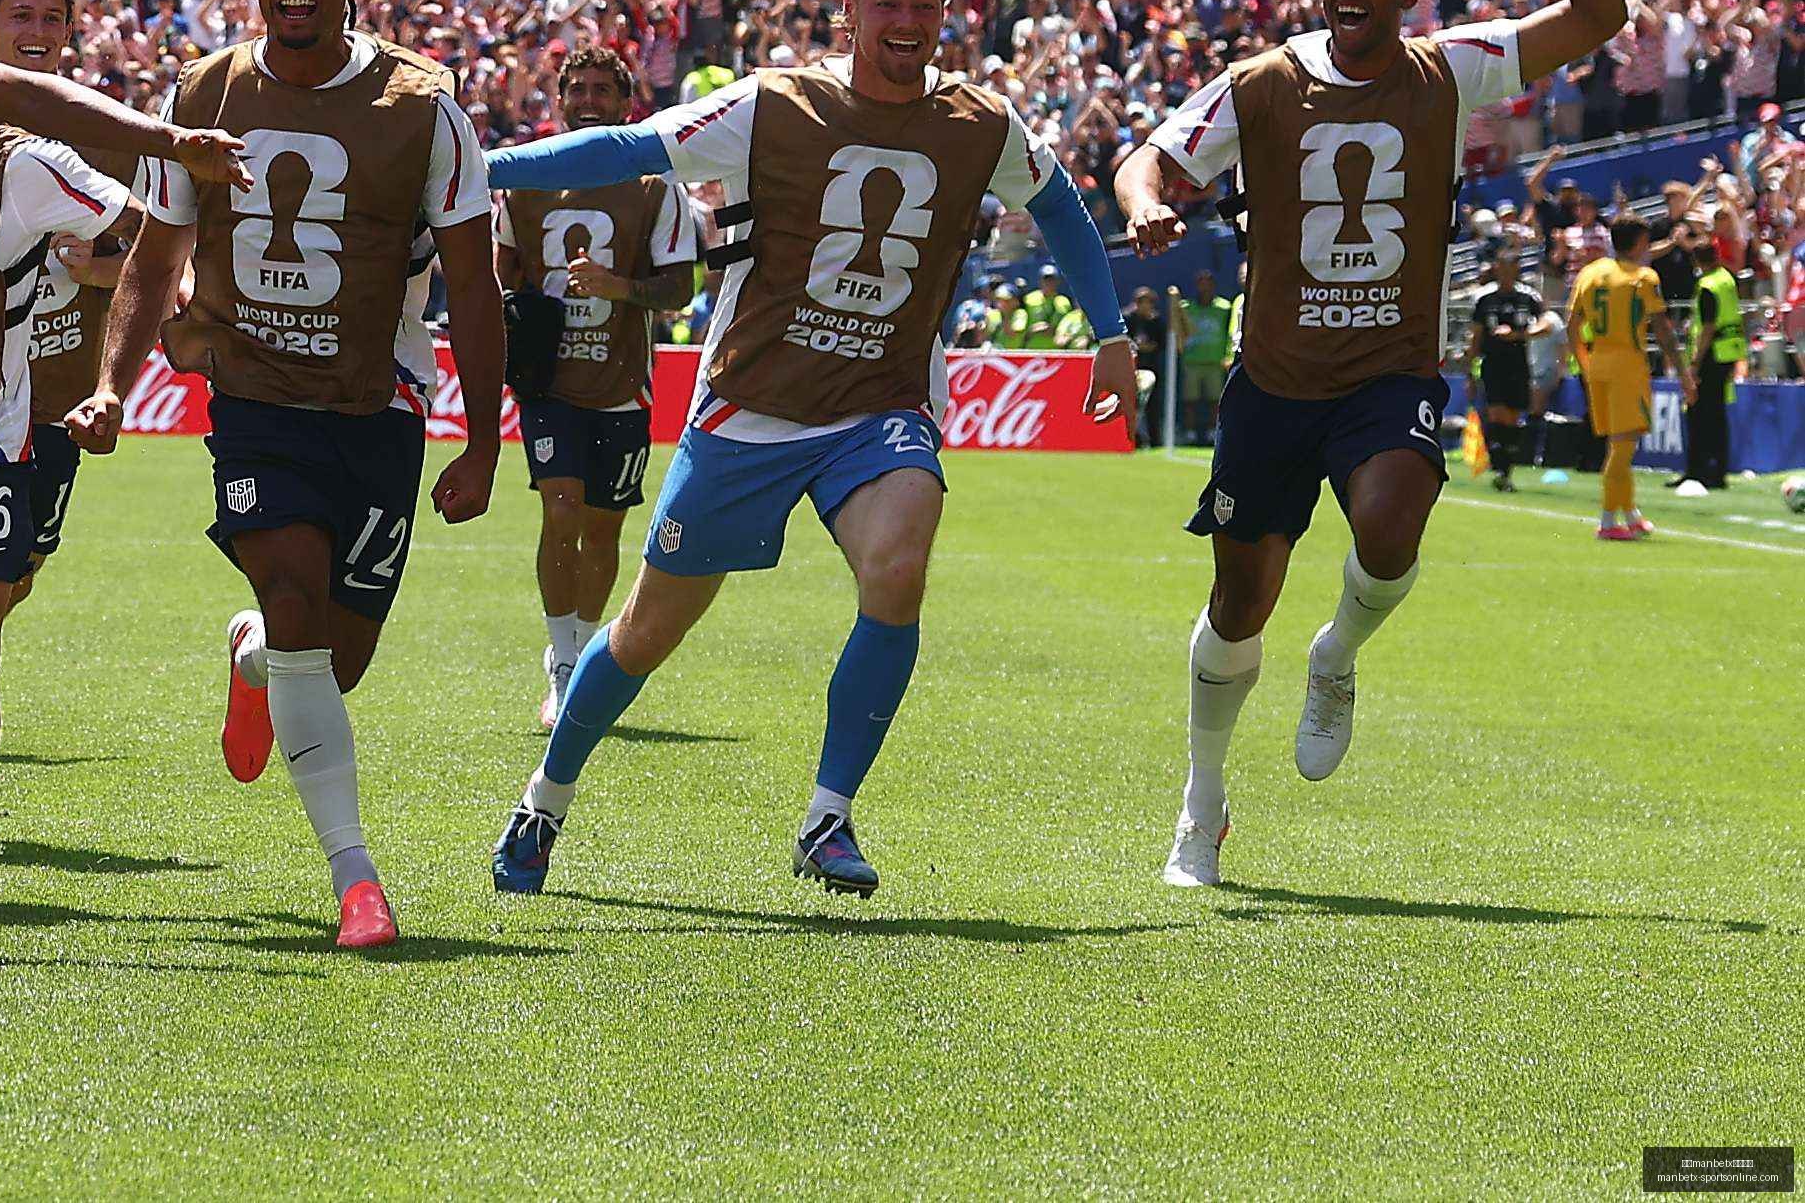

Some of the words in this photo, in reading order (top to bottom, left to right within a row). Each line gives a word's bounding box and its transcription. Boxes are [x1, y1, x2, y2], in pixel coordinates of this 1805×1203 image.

[1331, 251, 1378, 268] FIFA
[259, 268, 309, 290] FIFA
[835, 277, 882, 302] FIFA
[1301, 287, 1365, 302] WORLD
[1368, 287, 1402, 302] CUP
[52, 310, 81, 330] CUP
[236, 302, 296, 327] WORLD
[300, 314, 340, 329] CUP
[796, 306, 859, 331] WORLD
[861, 322, 895, 337] CUP
[1299, 304, 1401, 328] 2026
[584, 331, 611, 342] CUP
[783, 324, 885, 360] 2026
[615, 446, 646, 490] 10
[227, 478, 254, 495] USA
[662, 517, 681, 536] USA
[345, 506, 408, 578] 12
